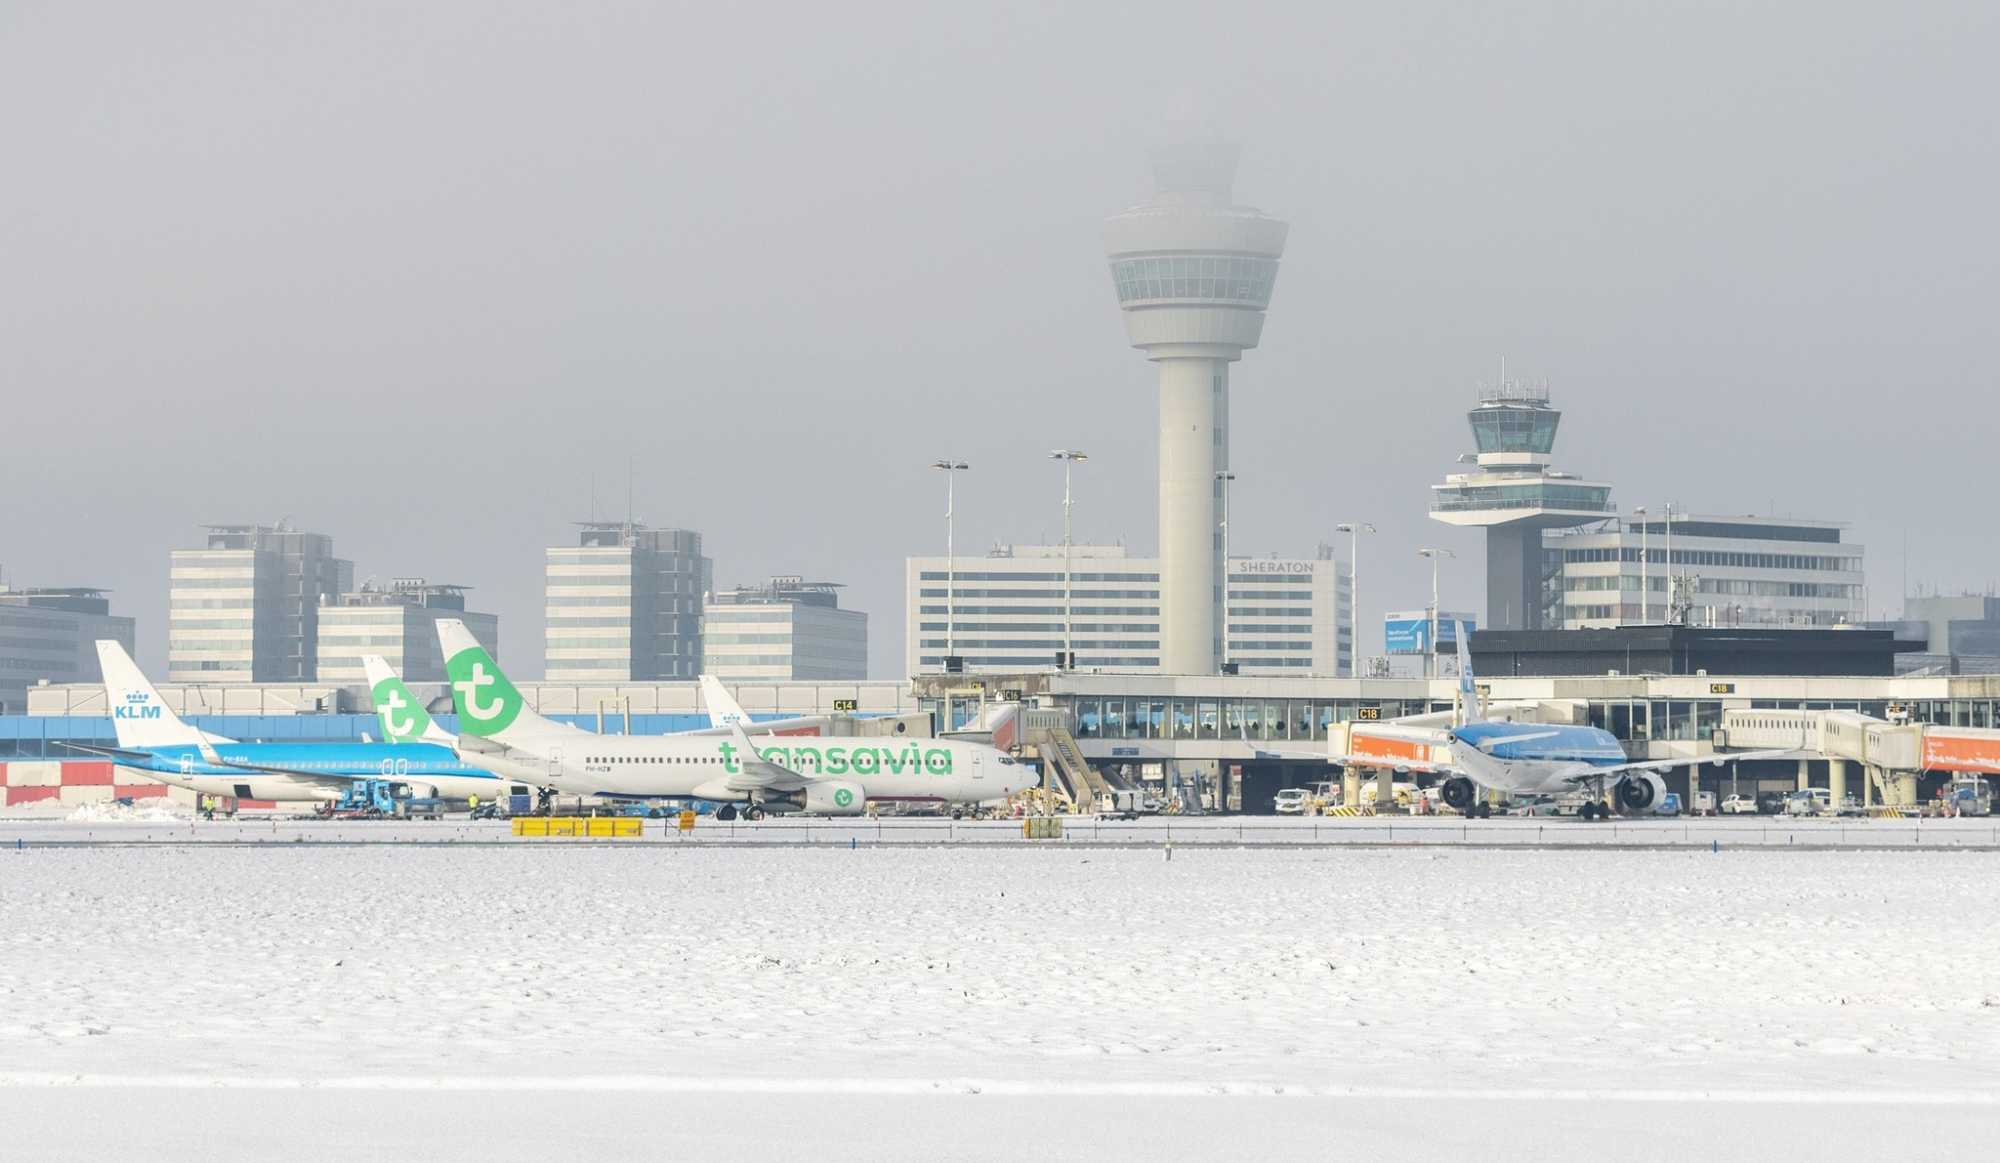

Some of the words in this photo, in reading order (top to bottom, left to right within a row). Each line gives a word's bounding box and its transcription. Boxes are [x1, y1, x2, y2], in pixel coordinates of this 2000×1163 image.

[1240, 561, 1313, 573] SHERATON
[835, 700, 853, 710] C14
[115, 706, 161, 719] KLM
[1360, 709, 1377, 719] C18
[719, 741, 953, 775] tansavia
